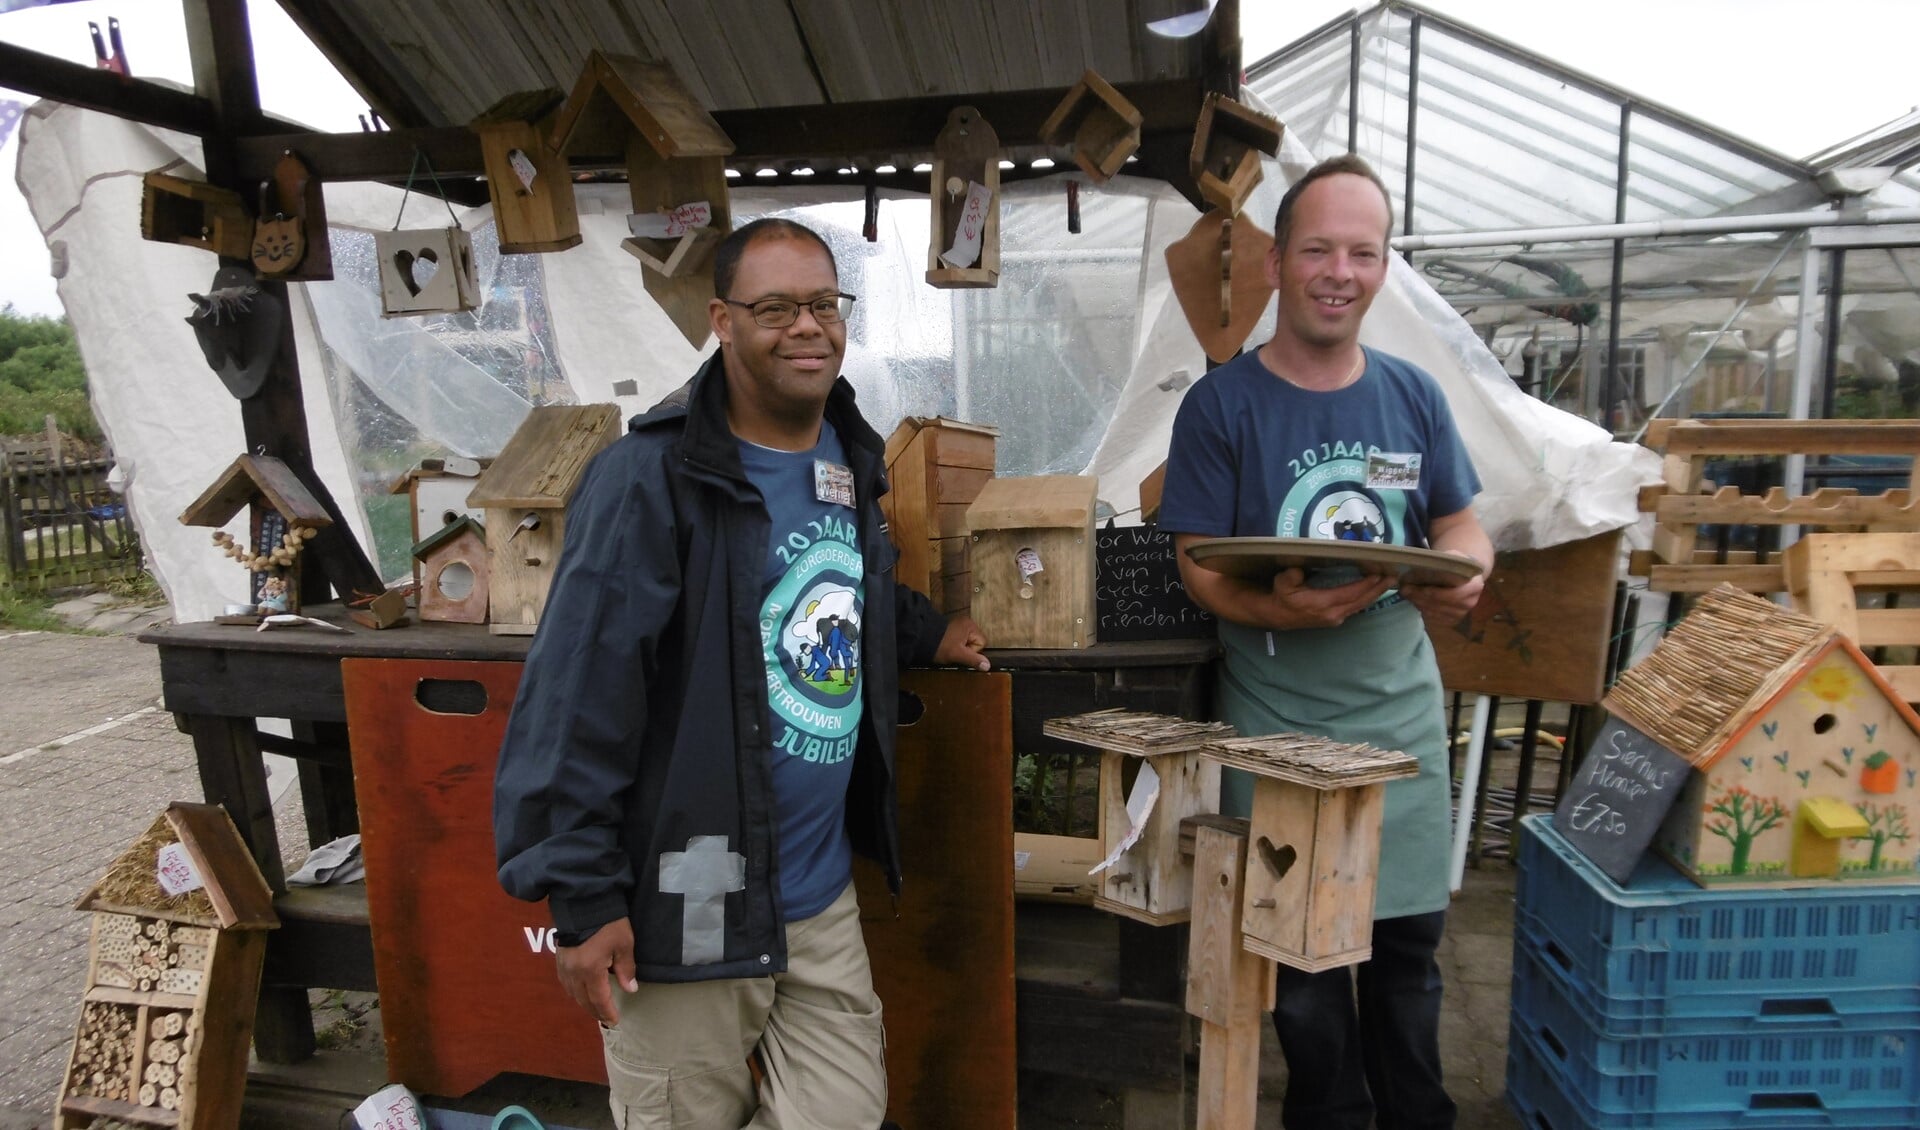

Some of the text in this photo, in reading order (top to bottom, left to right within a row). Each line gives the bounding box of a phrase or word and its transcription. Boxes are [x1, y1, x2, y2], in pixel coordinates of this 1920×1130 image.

[1288, 449, 1318, 478] 20
[1306, 465, 1363, 489] ZORGBOER
[1283, 507, 1298, 538] MOE
[776, 515, 856, 564] 20 JAAR
[794, 547, 863, 580] ZORGBOERDER
[1112, 567, 1149, 580] van
[1116, 600, 1143, 611] en
[1571, 792, 1626, 835] €7,50
